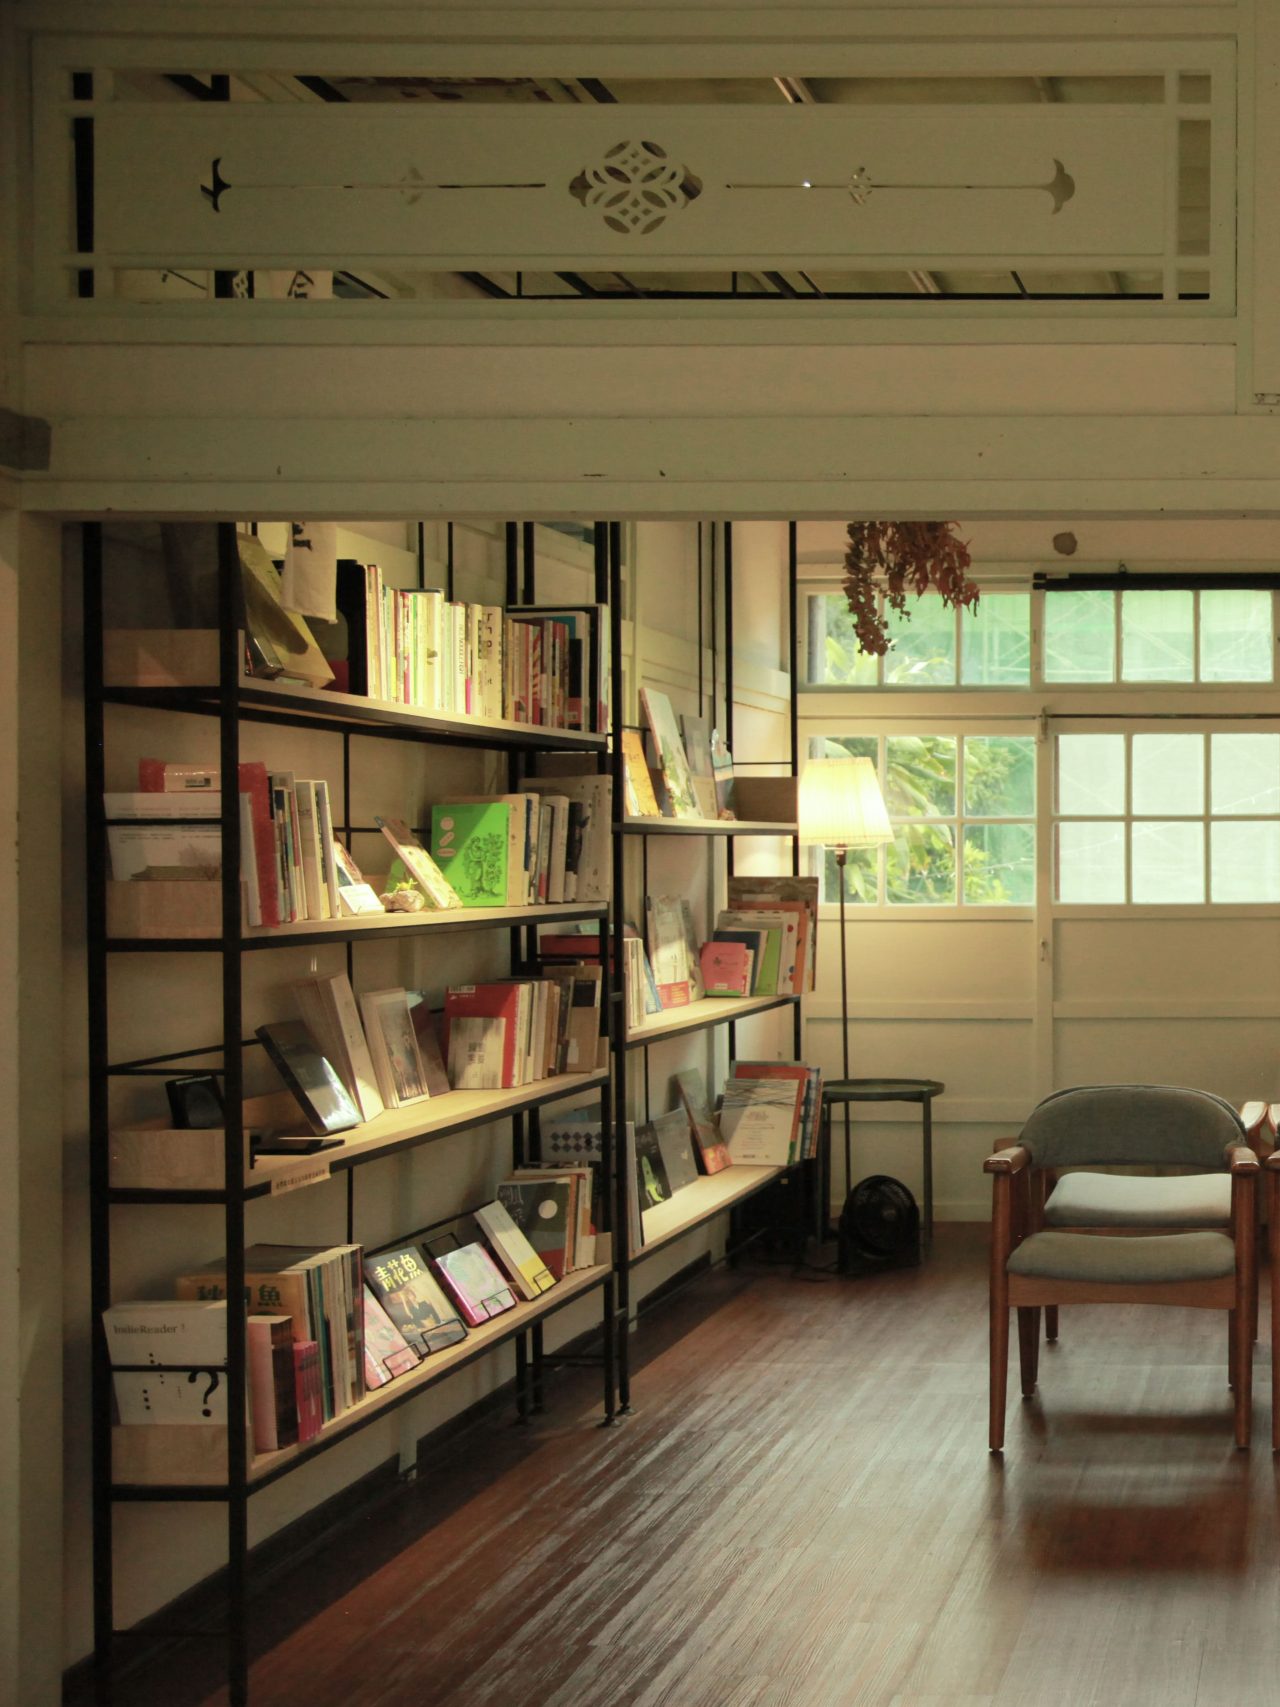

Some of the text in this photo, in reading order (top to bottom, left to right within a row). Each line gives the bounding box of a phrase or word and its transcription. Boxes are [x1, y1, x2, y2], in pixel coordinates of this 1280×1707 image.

[374, 1253, 424, 1292] 青花魚
[112, 1323, 178, 1335] IndieReader
